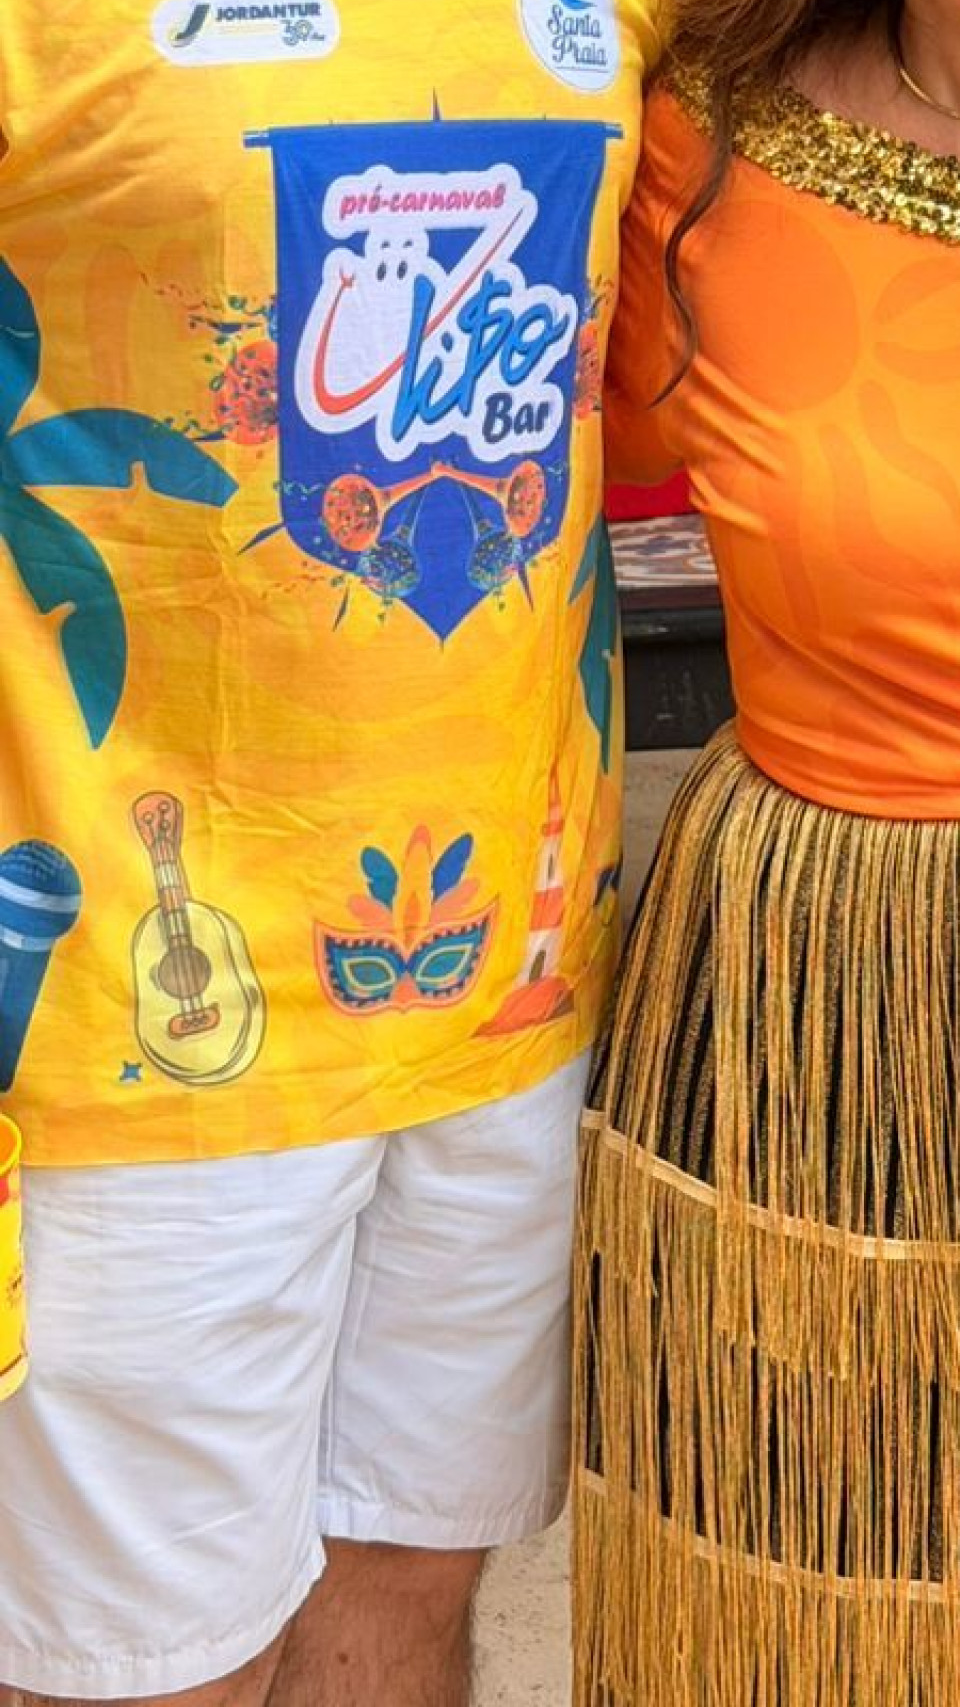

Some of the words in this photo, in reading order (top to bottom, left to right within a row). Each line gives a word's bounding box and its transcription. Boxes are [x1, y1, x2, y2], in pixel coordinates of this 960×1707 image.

[216, 2, 321, 22] JORDANTUR
[547, 4, 602, 37] Santa
[552, 35, 607, 65] Praia
[340, 183, 506, 220] pré-carnaval
[482, 391, 549, 444] Bar
